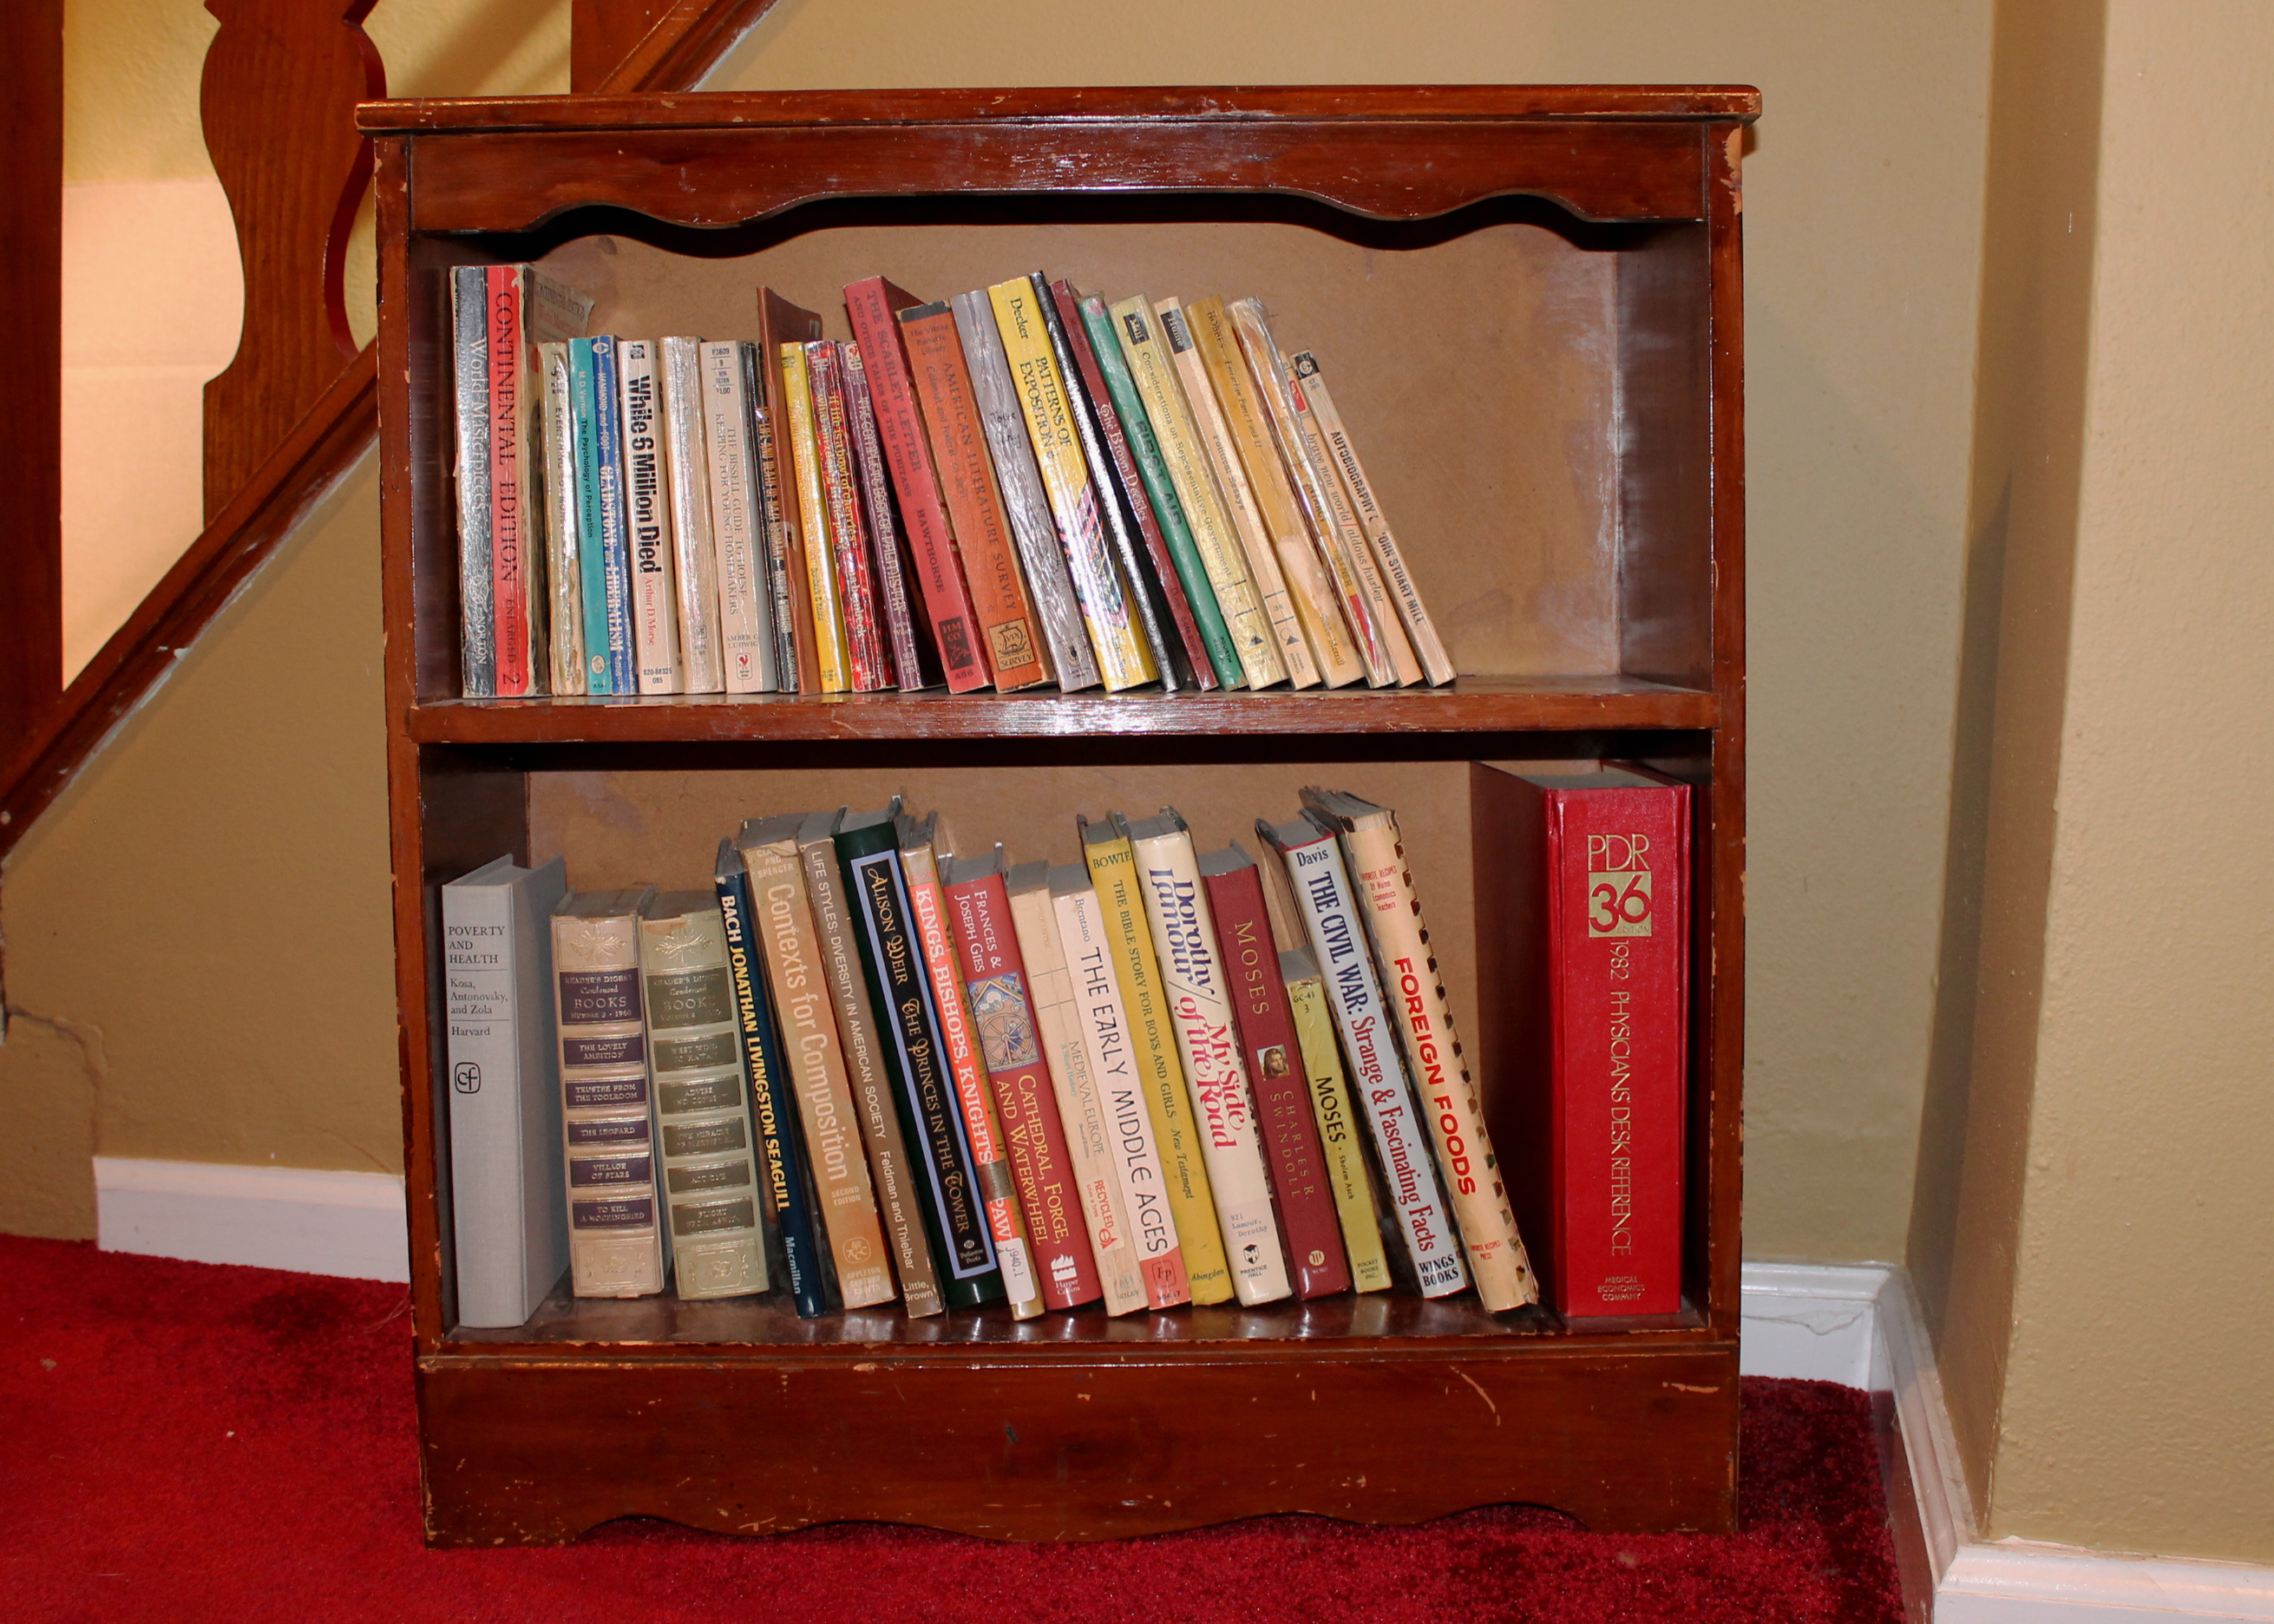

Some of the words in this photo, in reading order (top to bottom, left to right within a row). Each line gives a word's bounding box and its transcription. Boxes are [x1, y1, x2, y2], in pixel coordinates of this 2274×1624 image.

[1008, 297, 1031, 339] Decker
[1168, 316, 1184, 347] Hume
[1206, 311, 1225, 349] HOBBES
[469, 337, 488, 393] World
[495, 291, 516, 465] CONTINENTAL
[866, 291, 882, 324] THE
[876, 330, 904, 403] SCARLET
[897, 408, 922, 472] LETTER
[628, 375, 652, 434] While
[1019, 361, 1055, 447] EXPOSITION
[1034, 356, 1065, 427] PATTERNS
[1057, 426, 1073, 448] OF
[469, 400, 489, 509] Masterpieces
[631, 436, 654, 451] 6
[715, 413, 727, 460] KEEPING
[727, 427, 737, 449] THE
[718, 465, 729, 486] FOR
[729, 454, 739, 494] BISSELL
[942, 361, 972, 445] AMERICAN
[967, 453, 999, 545] LITERATURE
[993, 553, 1016, 609] SURVEY
[1098, 401, 1117, 430] The
[1108, 429, 1131, 472] Brown
[1124, 471, 1150, 522] Decades
[1141, 350, 1173, 424] Considerations
[1168, 427, 1177, 439] on
[1173, 441, 1208, 515] Representative
[1203, 514, 1232, 577] Government
[1212, 433, 1232, 474] Political
[1227, 475, 1246, 510] Essays
[1307, 432, 1326, 463] brave
[1320, 465, 1334, 488] new
[1331, 490, 1352, 522] world
[1329, 430, 1374, 514] AUTOBIOGRAPHY
[580, 436, 590, 481] Psychology
[585, 494, 593, 538] Perception
[632, 453, 658, 522] Million
[720, 491, 732, 531] YOUNG
[499, 481, 518, 581] EDITION
[732, 499, 743, 533] GUIDE
[637, 526, 661, 573] Died
[734, 540, 744, 553] TO
[916, 508, 945, 592] HAWTHORNE
[1347, 527, 1368, 564] aldous
[1362, 566, 1385, 602] huxley
[644, 577, 654, 606] Arthur
[724, 534, 738, 614] HOMEMAKERS
[1388, 559, 1412, 599] STUART
[1406, 599, 1425, 625] MILL
[476, 616, 486, 665] NORTON
[647, 618, 656, 645] Morse
[1000, 654, 1032, 668] SURVEY
[811, 851, 826, 878] LIFE
[1092, 852, 1131, 869] BOWIE
[1296, 847, 1329, 868] Davis
[1588, 834, 1650, 871] PDR
[818, 881, 837, 933] STYLES:
[1308, 871, 1340, 913] THE
[1589, 874, 1652, 933] 36
[449, 926, 505, 936] POVERTY
[722, 895, 741, 941] BACH
[767, 883, 807, 988] Contexts
[1074, 898, 1090, 942] Brentano
[1148, 868, 1193, 984] Lamour
[1172, 879, 1215, 995] Dorothy
[1320, 914, 1353, 963] CIVIL
[449, 940, 473, 950] AND
[449, 954, 499, 964] HEALTH
[830, 936, 854, 998] DIVERSITY
[990, 956, 1001, 968] &
[1234, 920, 1268, 1013] MOSES
[1610, 940, 1628, 979] 1982
[450, 979, 475, 989] Kosa,
[730, 946, 757, 1031] JONATHAN
[1081, 946, 1109, 996] THE
[1336, 963, 1367, 1014] WAR:
[450, 992, 508, 1003] Antonovsky,
[451, 1005, 467, 1014] and
[470, 1005, 493, 1014] Zola
[574, 996, 626, 1009] BOOKS
[790, 992, 818, 1028] for
[846, 1003, 857, 1015] IN
[1113, 880, 1127, 907] THE
[1120, 910, 1135, 945] BIBLE
[1129, 947, 1147, 986] STORY
[1138, 991, 1152, 1017] FOR
[1145, 1018, 1160, 1050] BOYS
[1153, 1054, 1167, 1078] AND
[1160, 1083, 1176, 1117] GIRLS
[1175, 997, 1210, 1034] of
[451, 1027, 490, 1036] Harvard
[598, 1043, 628, 1051] LOVELY
[915, 887, 944, 962] KINGS,
[933, 965, 968, 1063] BISHOPS,
[958, 1065, 993, 1162] KNIGHTS
[1092, 1004, 1127, 1074] EARLY
[849, 1019, 873, 1082] AMERICAN
[1186, 1027, 1212, 1077] the
[1351, 1016, 1382, 1084] Strange
[747, 1037, 776, 1135] LIVINGSTON
[1069, 1041, 1092, 1107] MEDIEVAL
[1085, 1107, 1104, 1154] EUROPE
[1204, 1022, 1230, 1065] My
[1217, 1070, 1245, 1131] Side
[1372, 1089, 1395, 1105] &
[1394, 958, 1444, 1084] FOREIGN
[1433, 1096, 1475, 1195] FOODS
[800, 1033, 849, 1179] Composition
[865, 1085, 885, 1138] SOCIETY
[1196, 1077, 1237, 1150] Road
[1315, 1077, 1346, 1142] MOSES
[1611, 1107, 1630, 1154] DESK
[1111, 1090, 1151, 1182] MIDDLE
[1269, 1093, 1300, 1197] SWINDOLL
[1282, 1090, 1308, 1176] CHARLES
[1303, 1185, 1314, 1200] R.
[1379, 1105, 1420, 1205] Fascinating
[765, 1138, 790, 1210] SEAGULL
[880, 1150, 897, 1199] Feldman
[1170, 1129, 1182, 1149] New
[1176, 1153, 1194, 1198] Testament
[831, 1186, 859, 1198] SECOND
[834, 1195, 862, 1206] EDITION
[891, 1202, 905, 1221] and
[1093, 1179, 1114, 1228] RECYCLED
[1611, 1157, 1630, 1254] REFERENCE
[897, 1224, 914, 1268] Thielbar
[1135, 1193, 1168, 1252] AGES
[1232, 1220, 1262, 1228] Lamour,
[1238, 1227, 1267, 1237] Dorothy
[1408, 1204, 1435, 1251] Facts
[785, 1236, 801, 1293] Macmillan
[902, 1280, 929, 1291] Little,
[1419, 1254, 1455, 1274] WINGS
[1423, 1267, 1458, 1287] BOOKS
[1598, 1284, 1645, 1293] ECONOMICS
[905, 1289, 934, 1301] Brown
[1602, 1293, 1642, 1301] COMPANY
